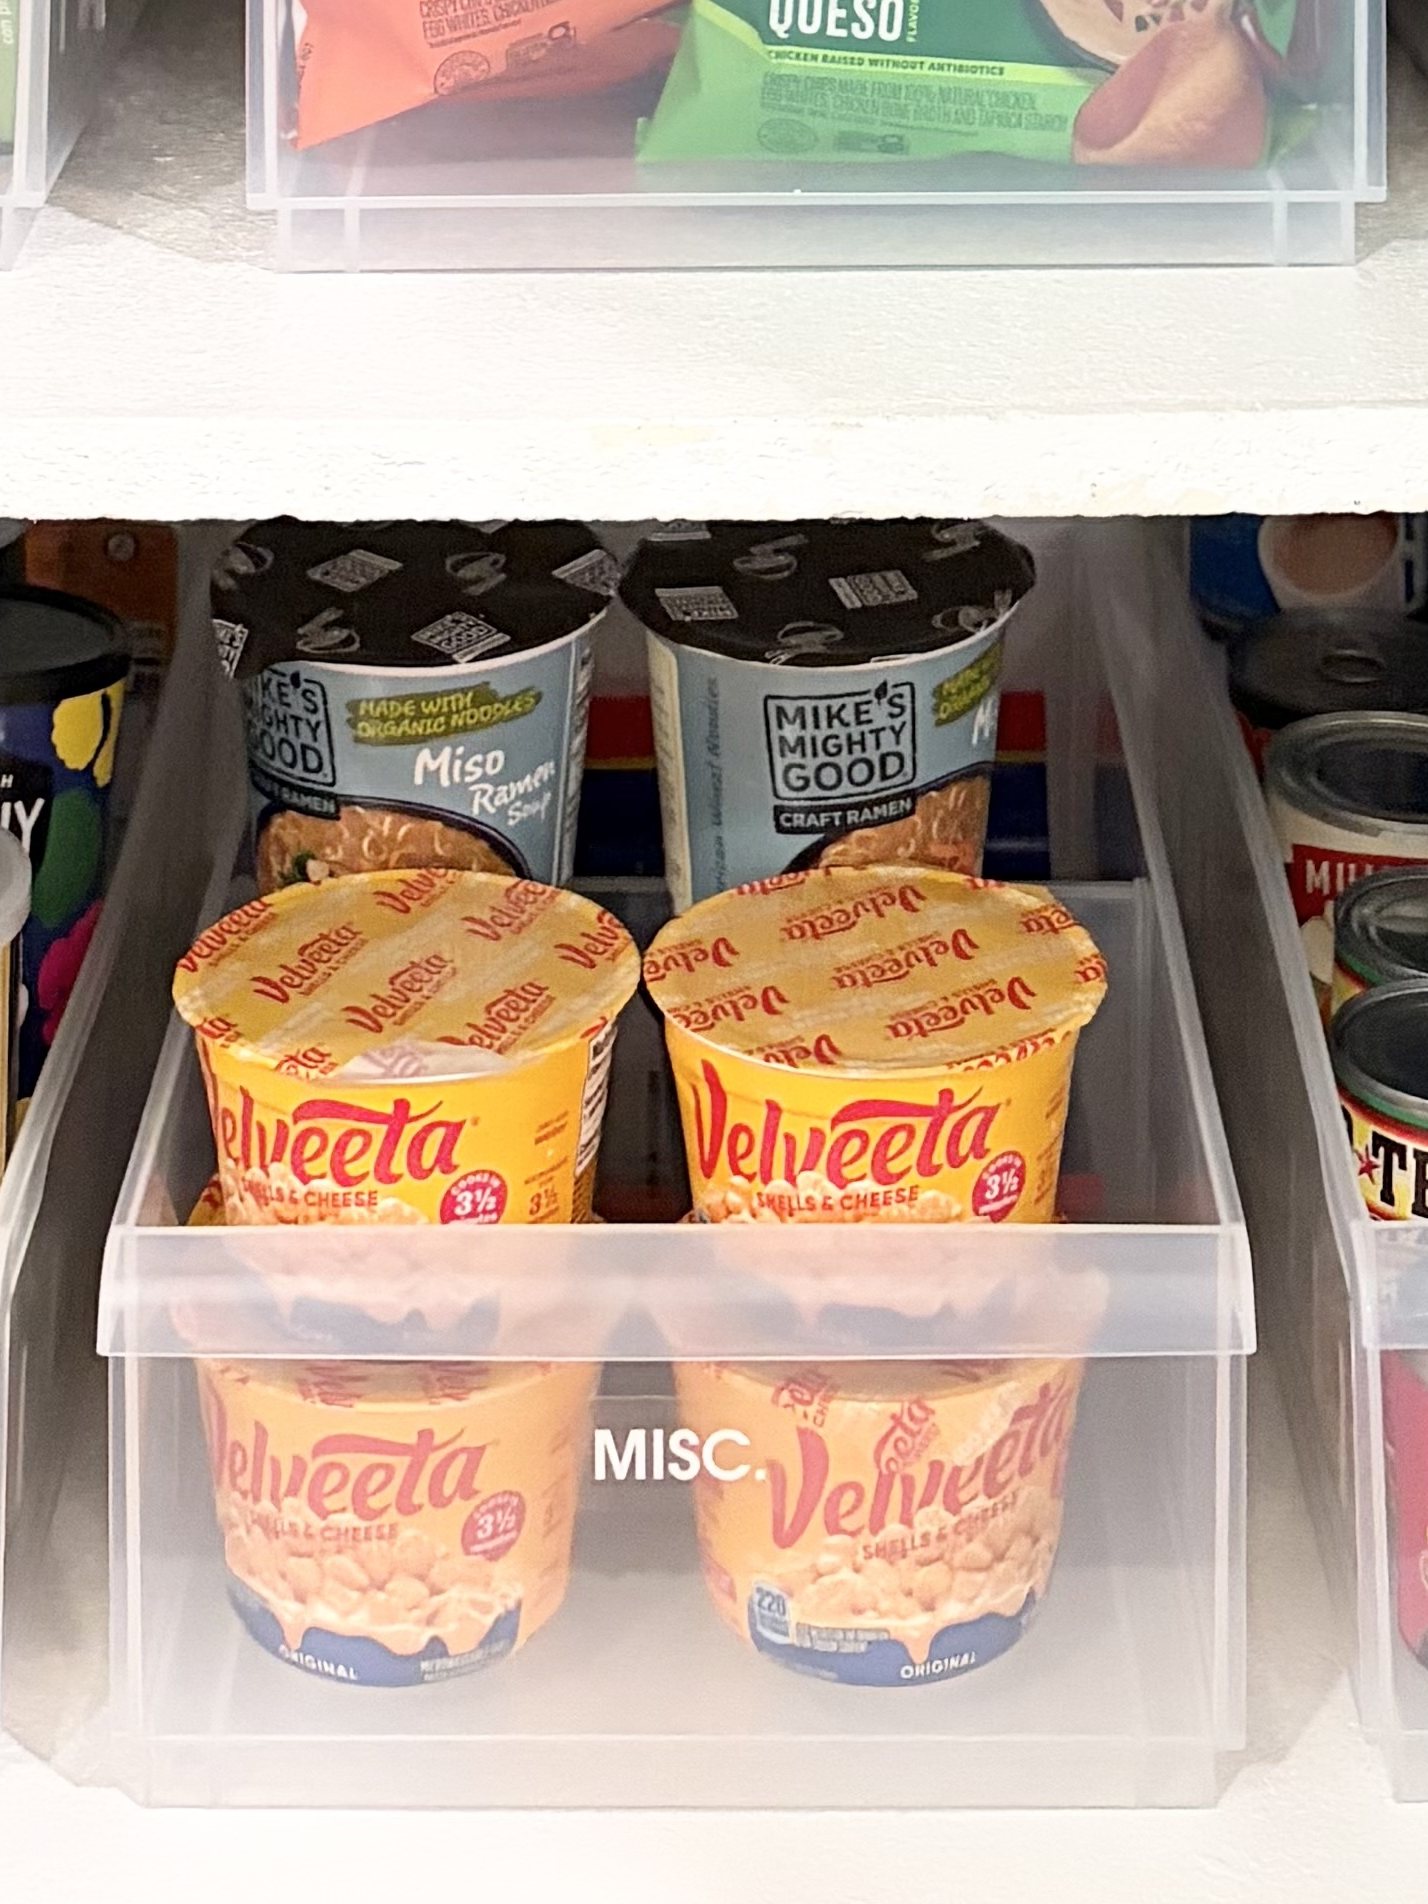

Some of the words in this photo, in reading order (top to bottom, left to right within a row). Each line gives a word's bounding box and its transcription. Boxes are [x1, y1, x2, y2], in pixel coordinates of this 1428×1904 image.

[776, 693, 905, 730] MIKE'S
[779, 722, 906, 758] MIGHTY
[414, 747, 505, 787] Miso
[783, 753, 904, 793] GOOD
[779, 808, 842, 827] CRAFT
[847, 797, 912, 823] RAMEN
[696, 1060, 1006, 1194] Velveeta
[842, 1184, 920, 1208] CHEESE
[594, 1428, 766, 1482] MISC.
